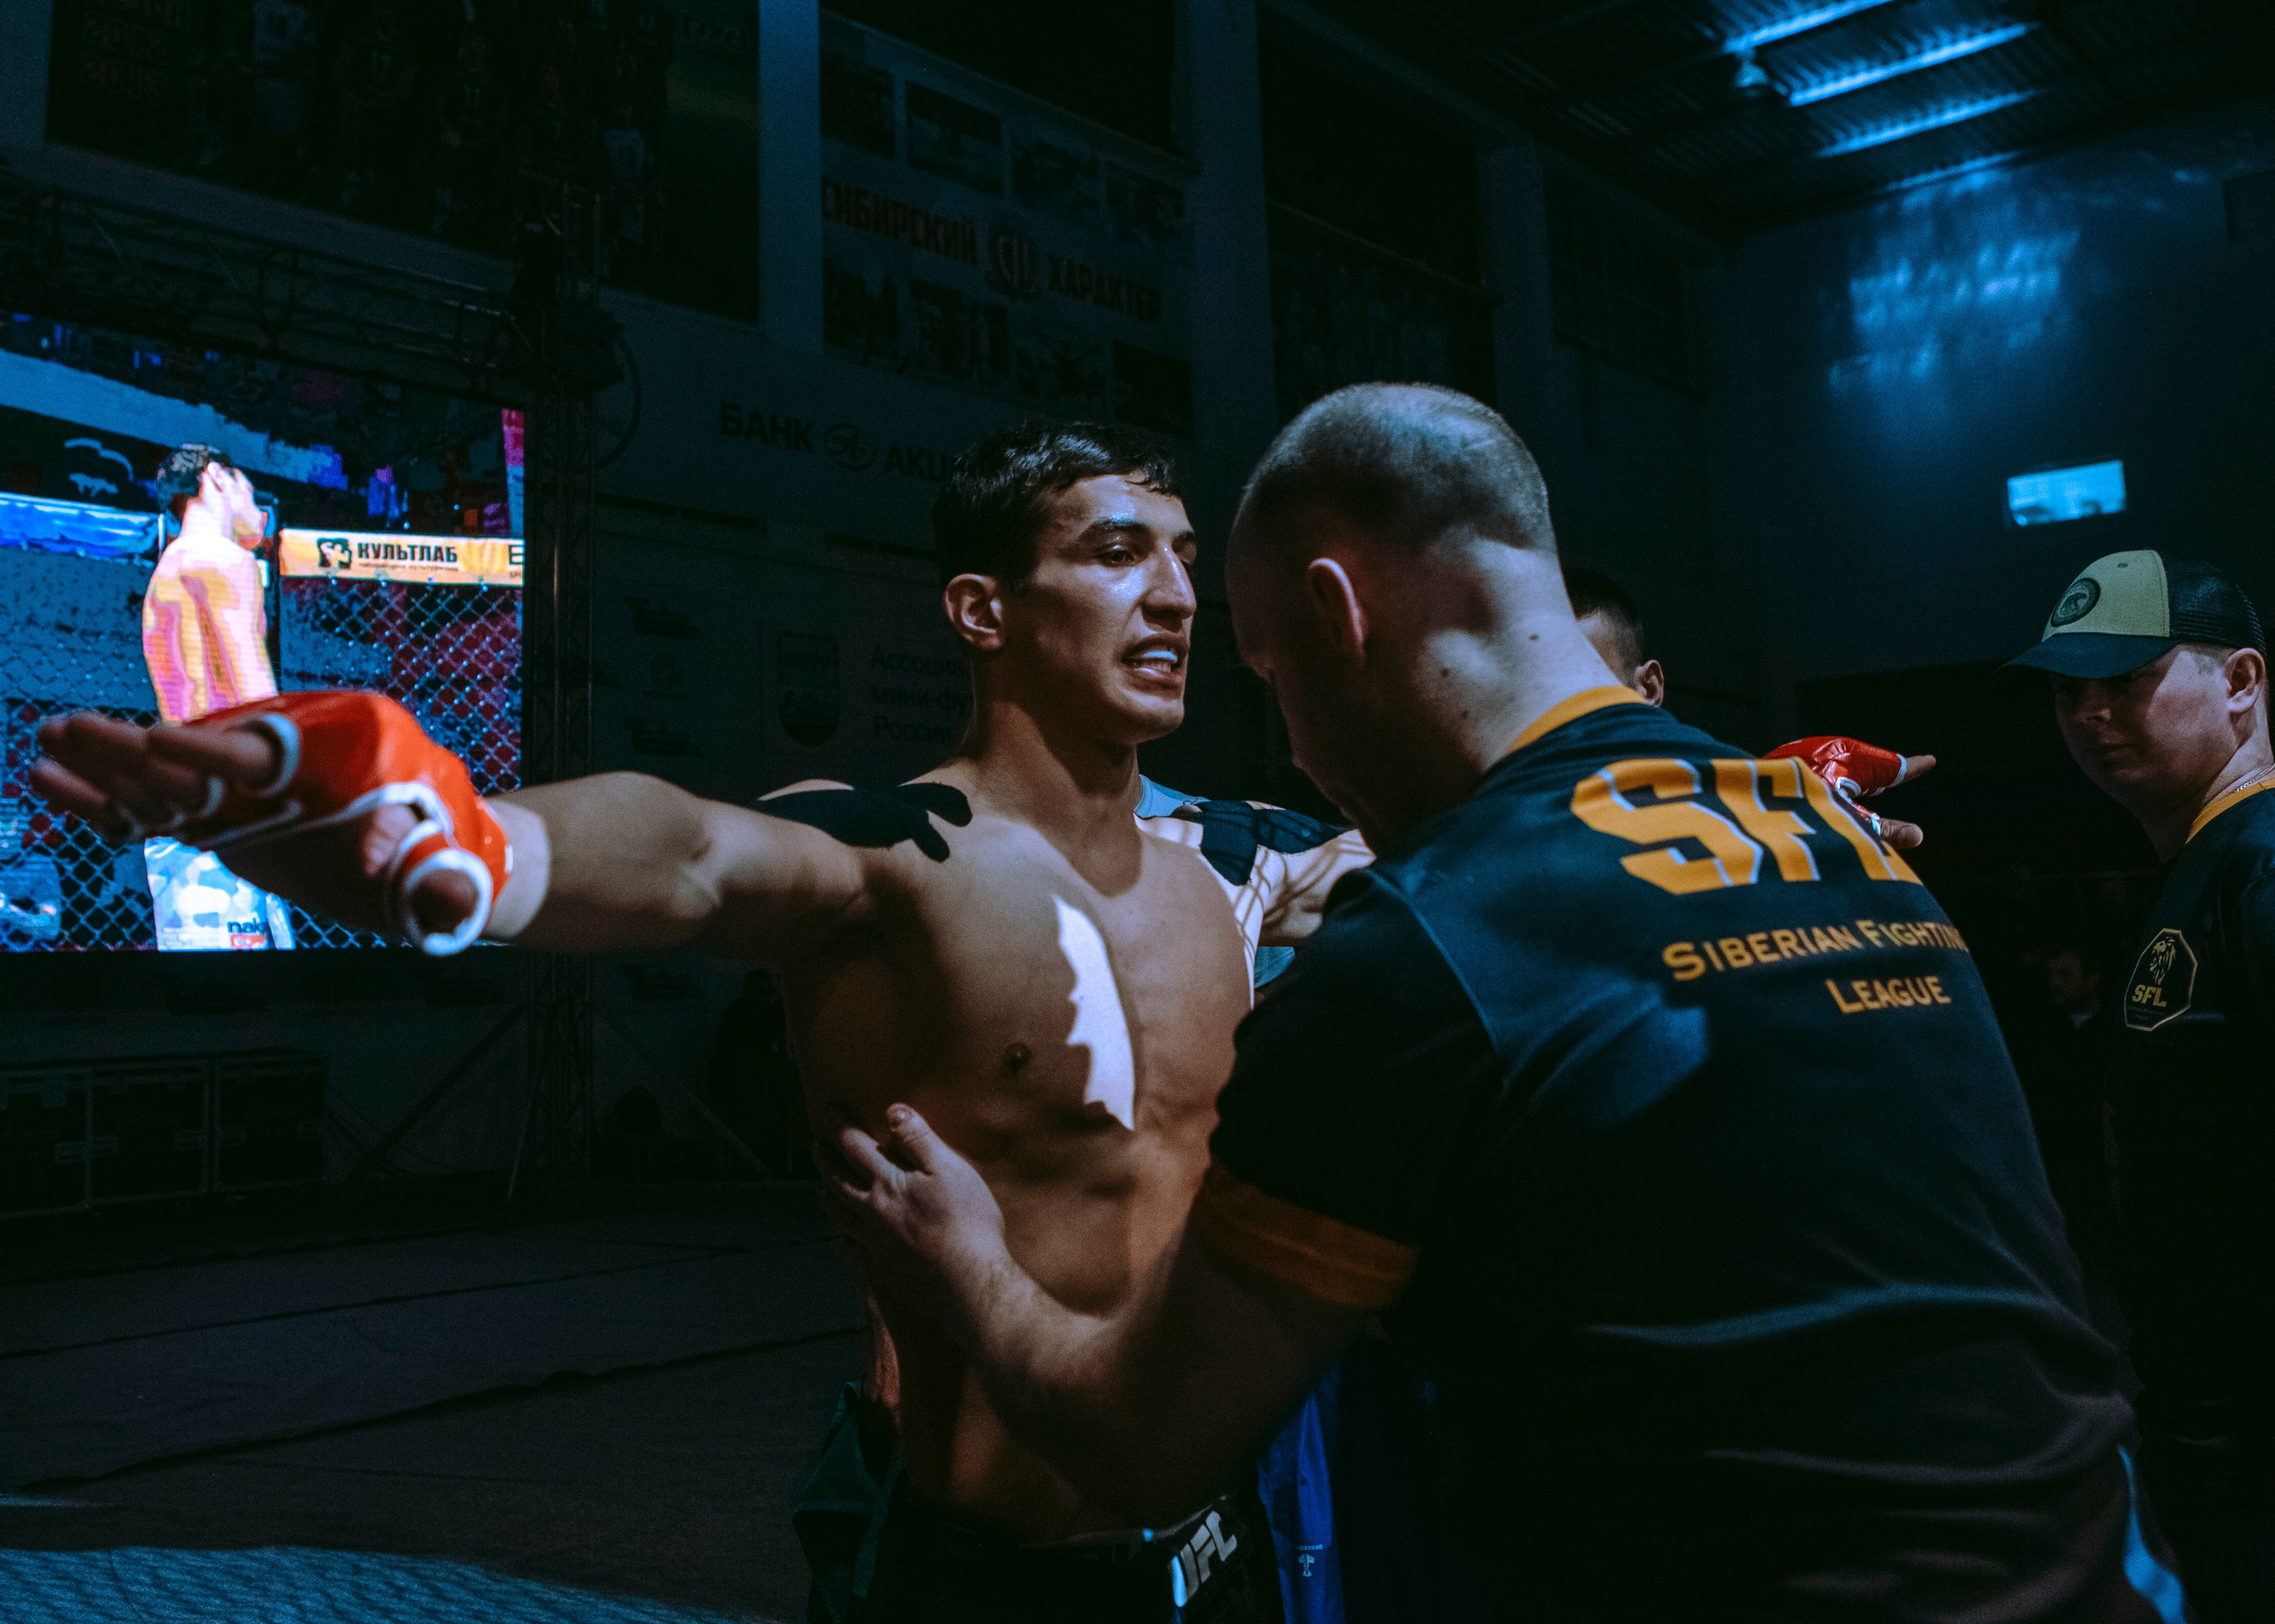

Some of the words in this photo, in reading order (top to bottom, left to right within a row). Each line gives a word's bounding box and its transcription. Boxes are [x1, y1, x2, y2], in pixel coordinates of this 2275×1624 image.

[822, 177, 978, 266] СИБИРСКИЙ
[1048, 254, 1161, 322] ХАРАКТЕР
[720, 401, 814, 455] БАНК
[884, 442, 949, 483] АКЦ
[357, 542, 458, 563] КУЛЬТЛАБ
[871, 645, 968, 678] Ассоциа
[870, 685, 972, 720] мини-фу
[874, 714, 954, 744] России
[1570, 758, 1923, 896] SFL
[2131, 983, 2167, 1007] SFL
[1167, 1510, 1238, 1607] UFC
